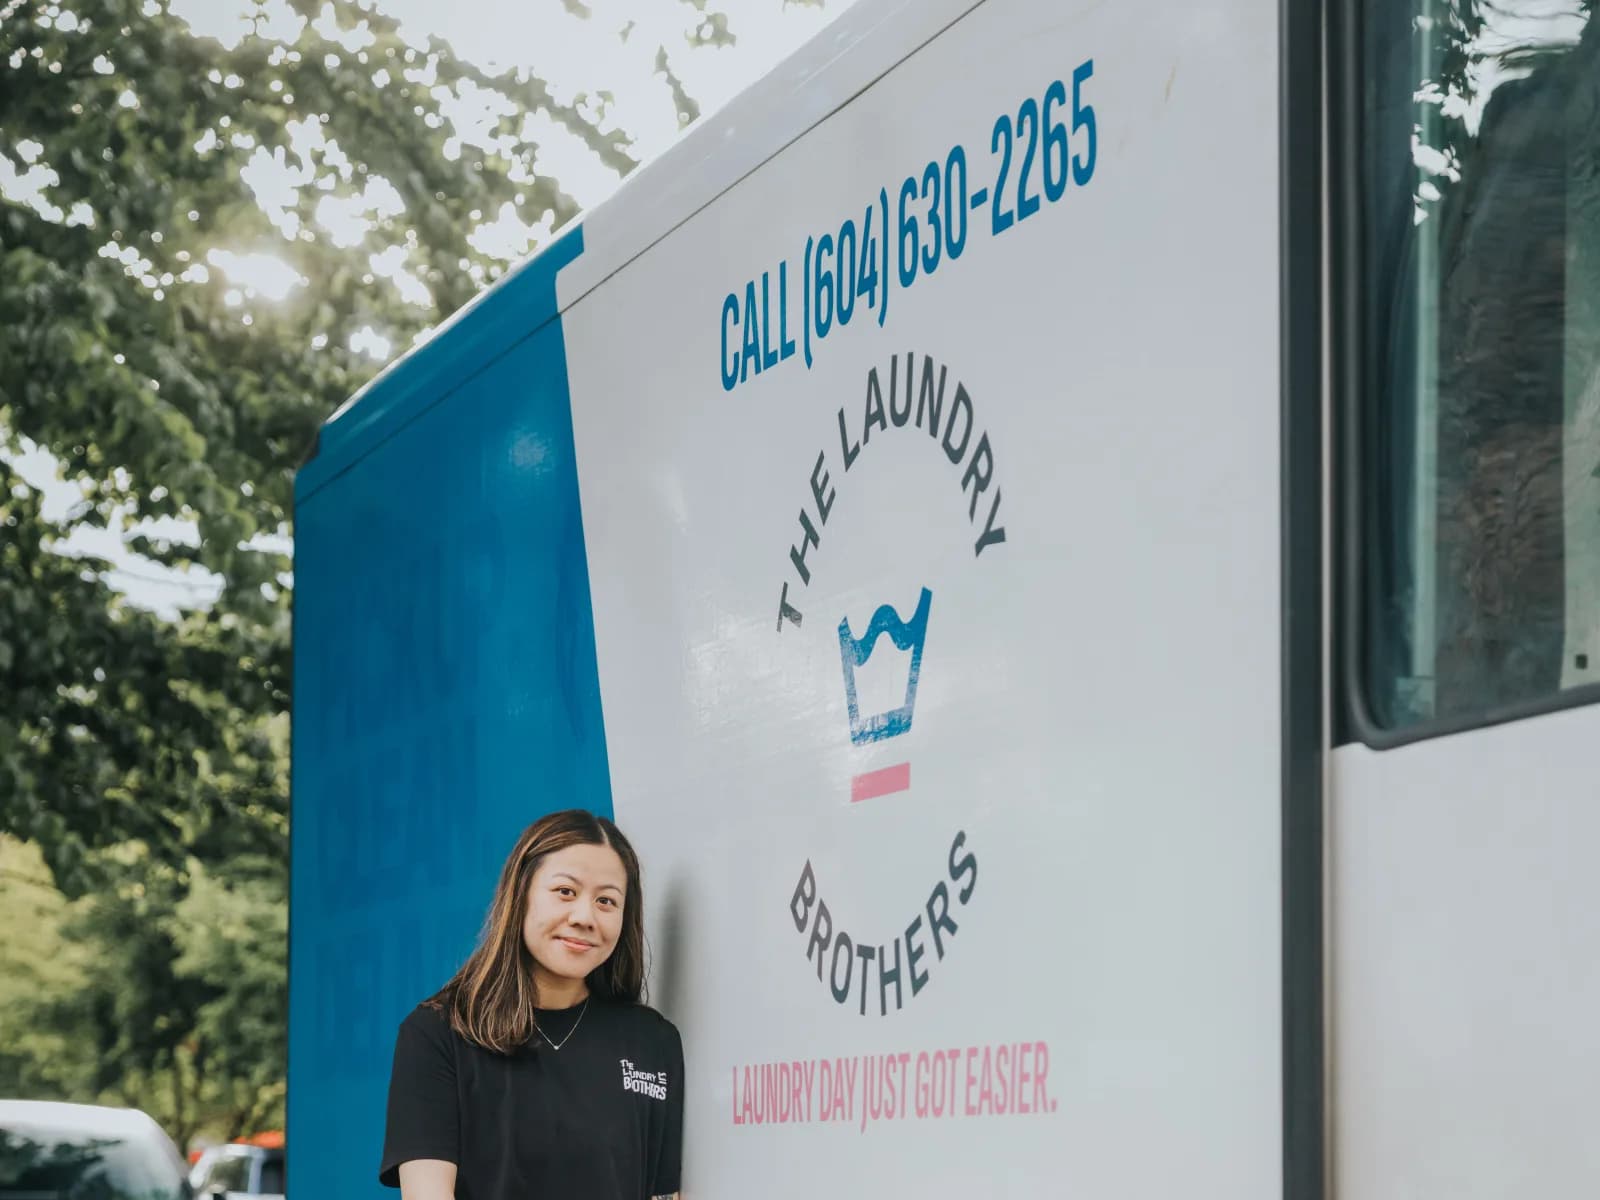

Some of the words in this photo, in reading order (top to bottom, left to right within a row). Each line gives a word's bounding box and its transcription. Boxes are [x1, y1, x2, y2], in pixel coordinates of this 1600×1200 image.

[720, 260, 796, 391] CALL
[804, 186, 889, 370] (604)
[898, 58, 1097, 288] 630-2265
[776, 450, 836, 633] THE
[838, 351, 1006, 558] LAUNDRY
[790, 830, 978, 1016] BROTHERS
[732, 1060, 815, 1125] LAUNDRY
[818, 1056, 858, 1122] DAY
[860, 1052, 911, 1135] JUST
[915, 1048, 961, 1119] GOT
[964, 1040, 1059, 1117] EASIER.
